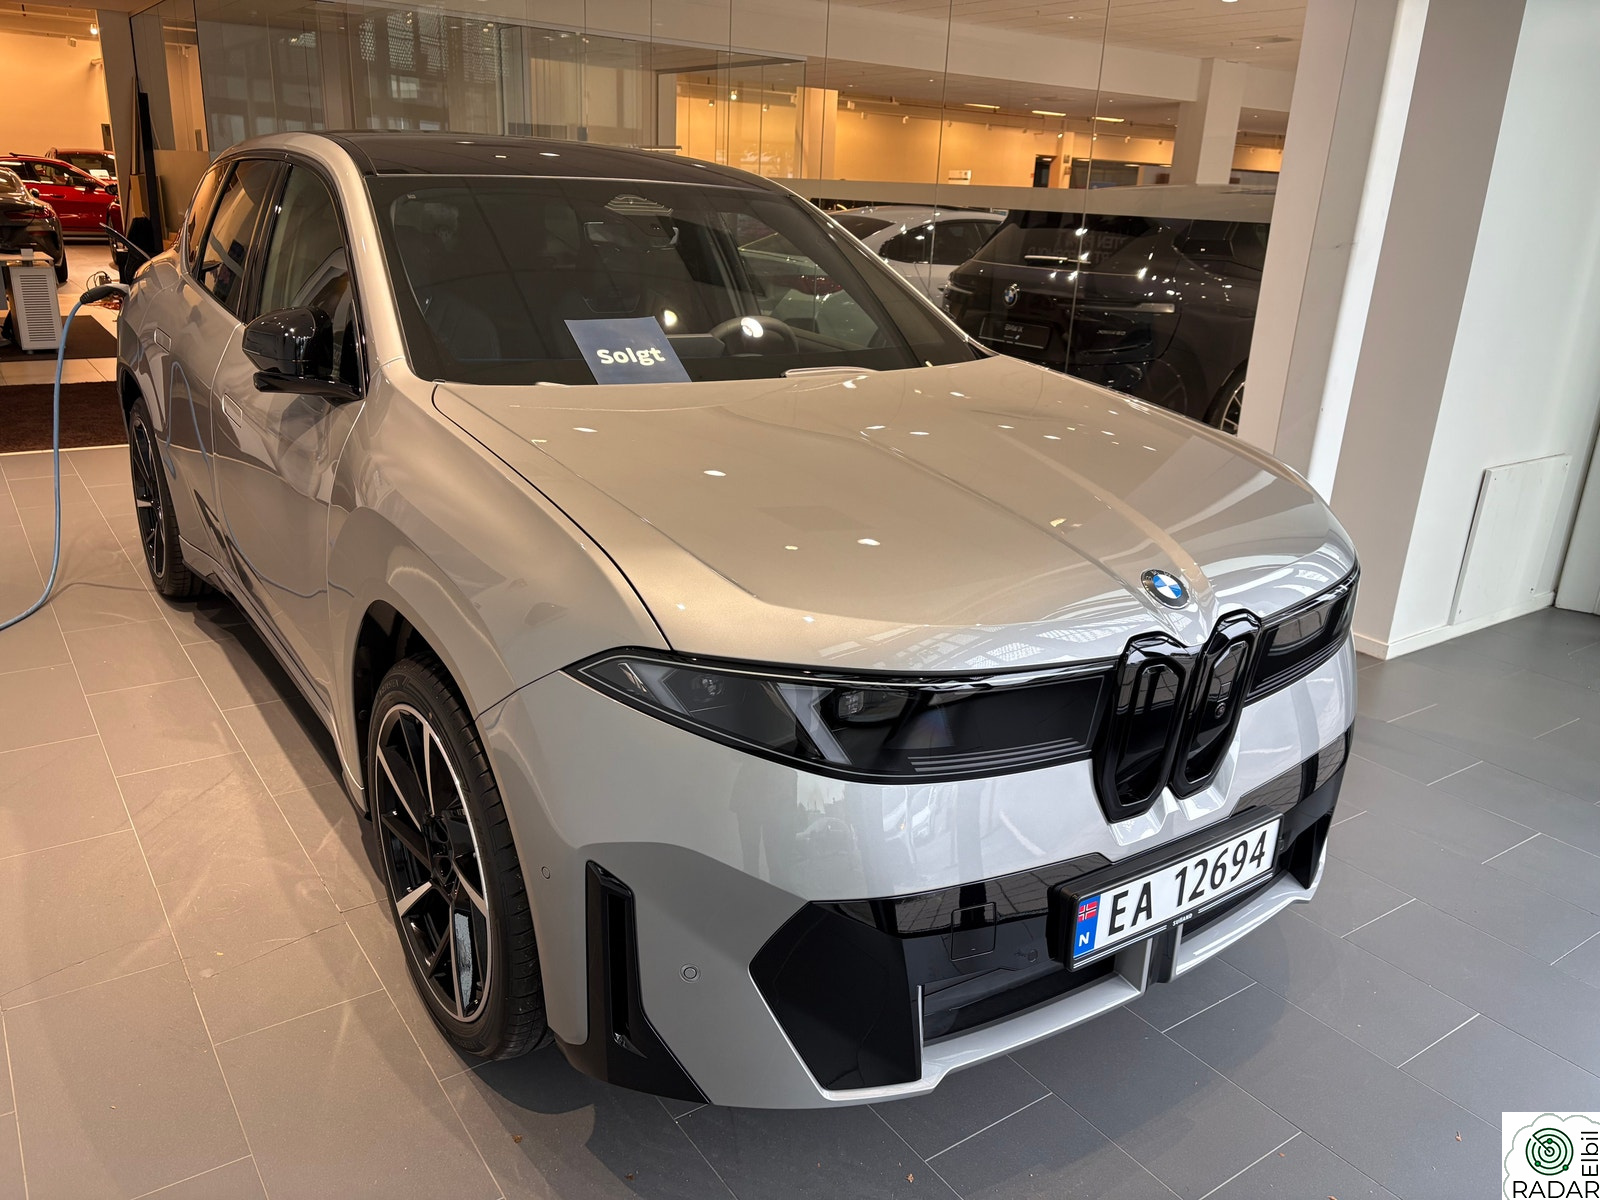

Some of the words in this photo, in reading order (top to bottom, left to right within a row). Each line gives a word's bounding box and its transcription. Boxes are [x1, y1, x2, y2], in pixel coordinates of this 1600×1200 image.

[596, 347, 666, 366] Solgt
[1108, 881, 1153, 937] EA
[1175, 830, 1268, 908] 12694
[1078, 931, 1090, 947] N
